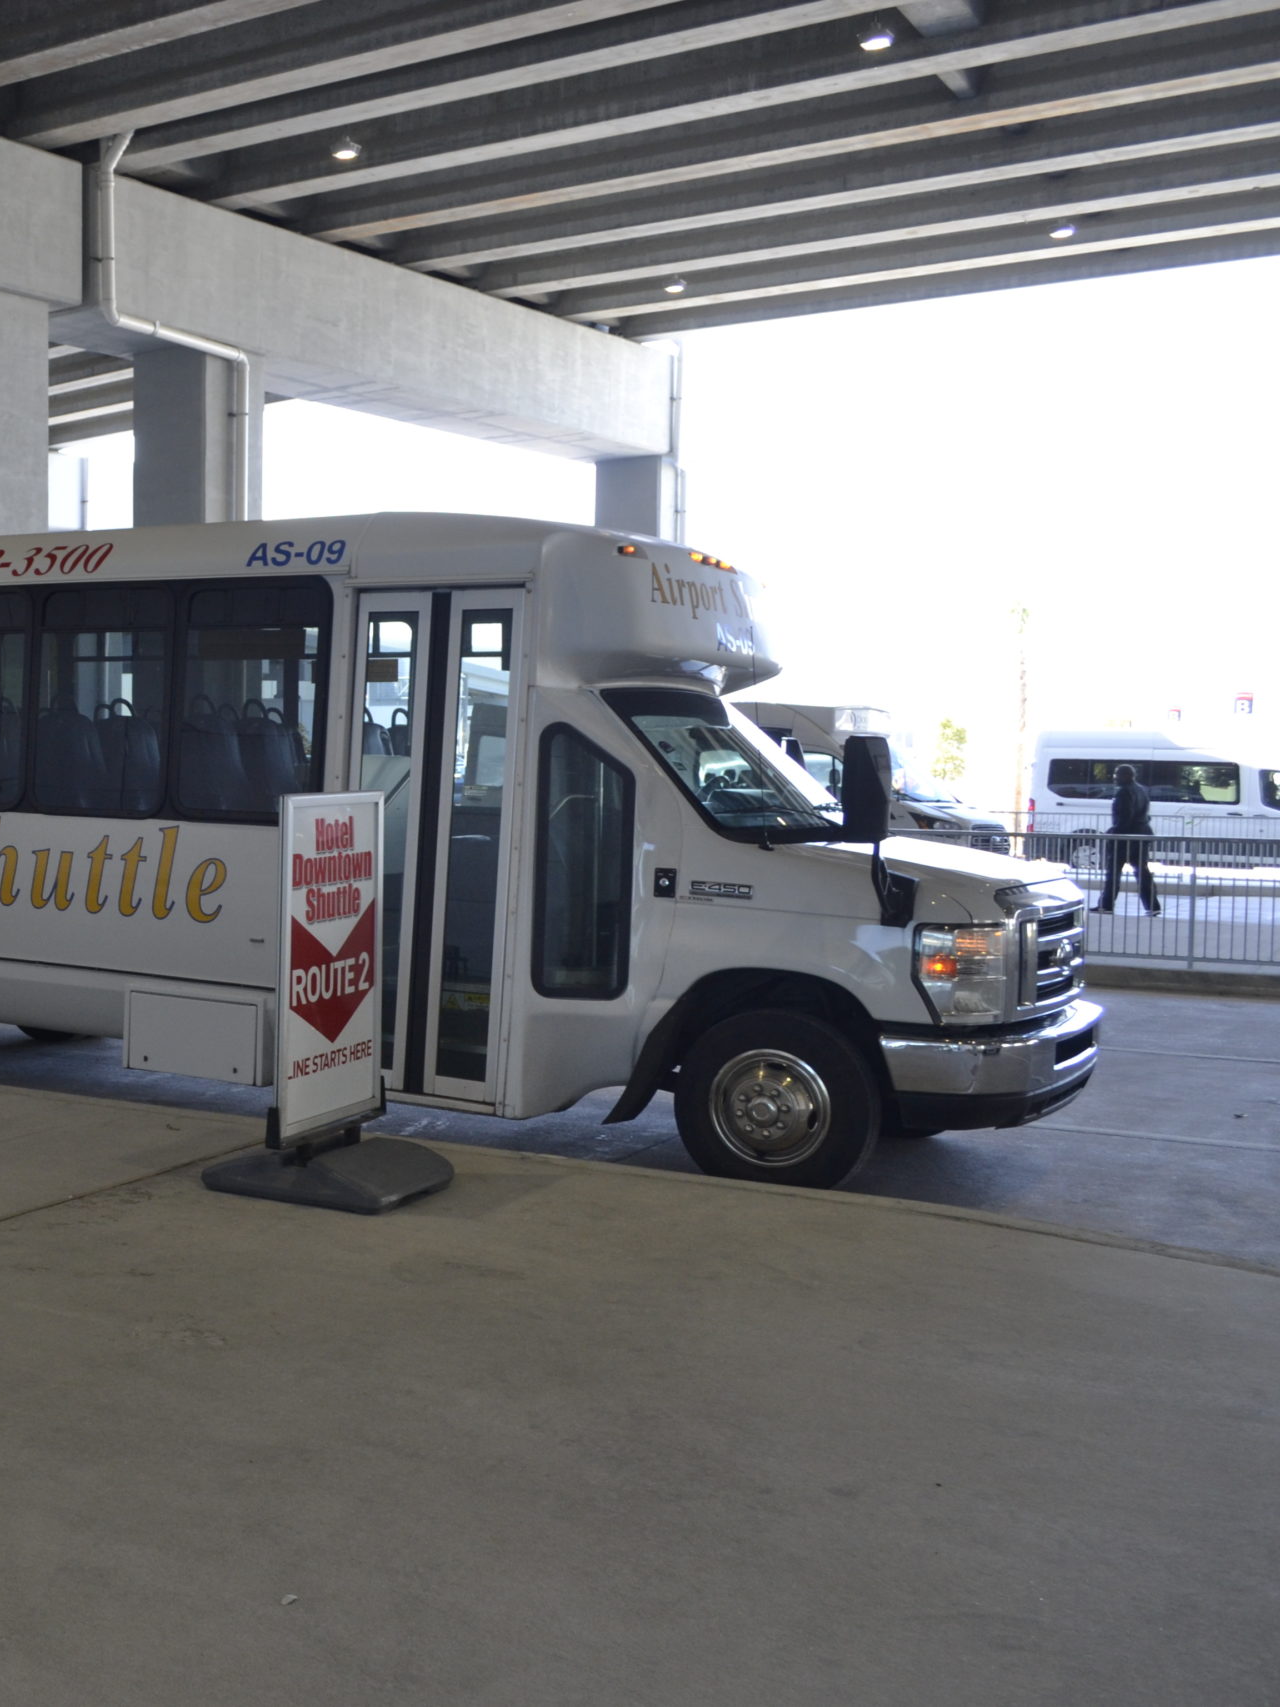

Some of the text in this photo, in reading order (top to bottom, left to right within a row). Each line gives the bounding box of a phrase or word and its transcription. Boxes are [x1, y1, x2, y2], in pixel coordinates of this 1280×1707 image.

[245, 539, 347, 567] AS-09
[650, 561, 728, 620] Airport
[315, 815, 355, 853] Hotel
[292, 850, 373, 889] Downtown
[305, 883, 361, 924] Shuttle
[291, 951, 370, 1007] ROUTE 2
[312, 1047, 348, 1074] STARTS
[349, 1039, 373, 1063] HERE
